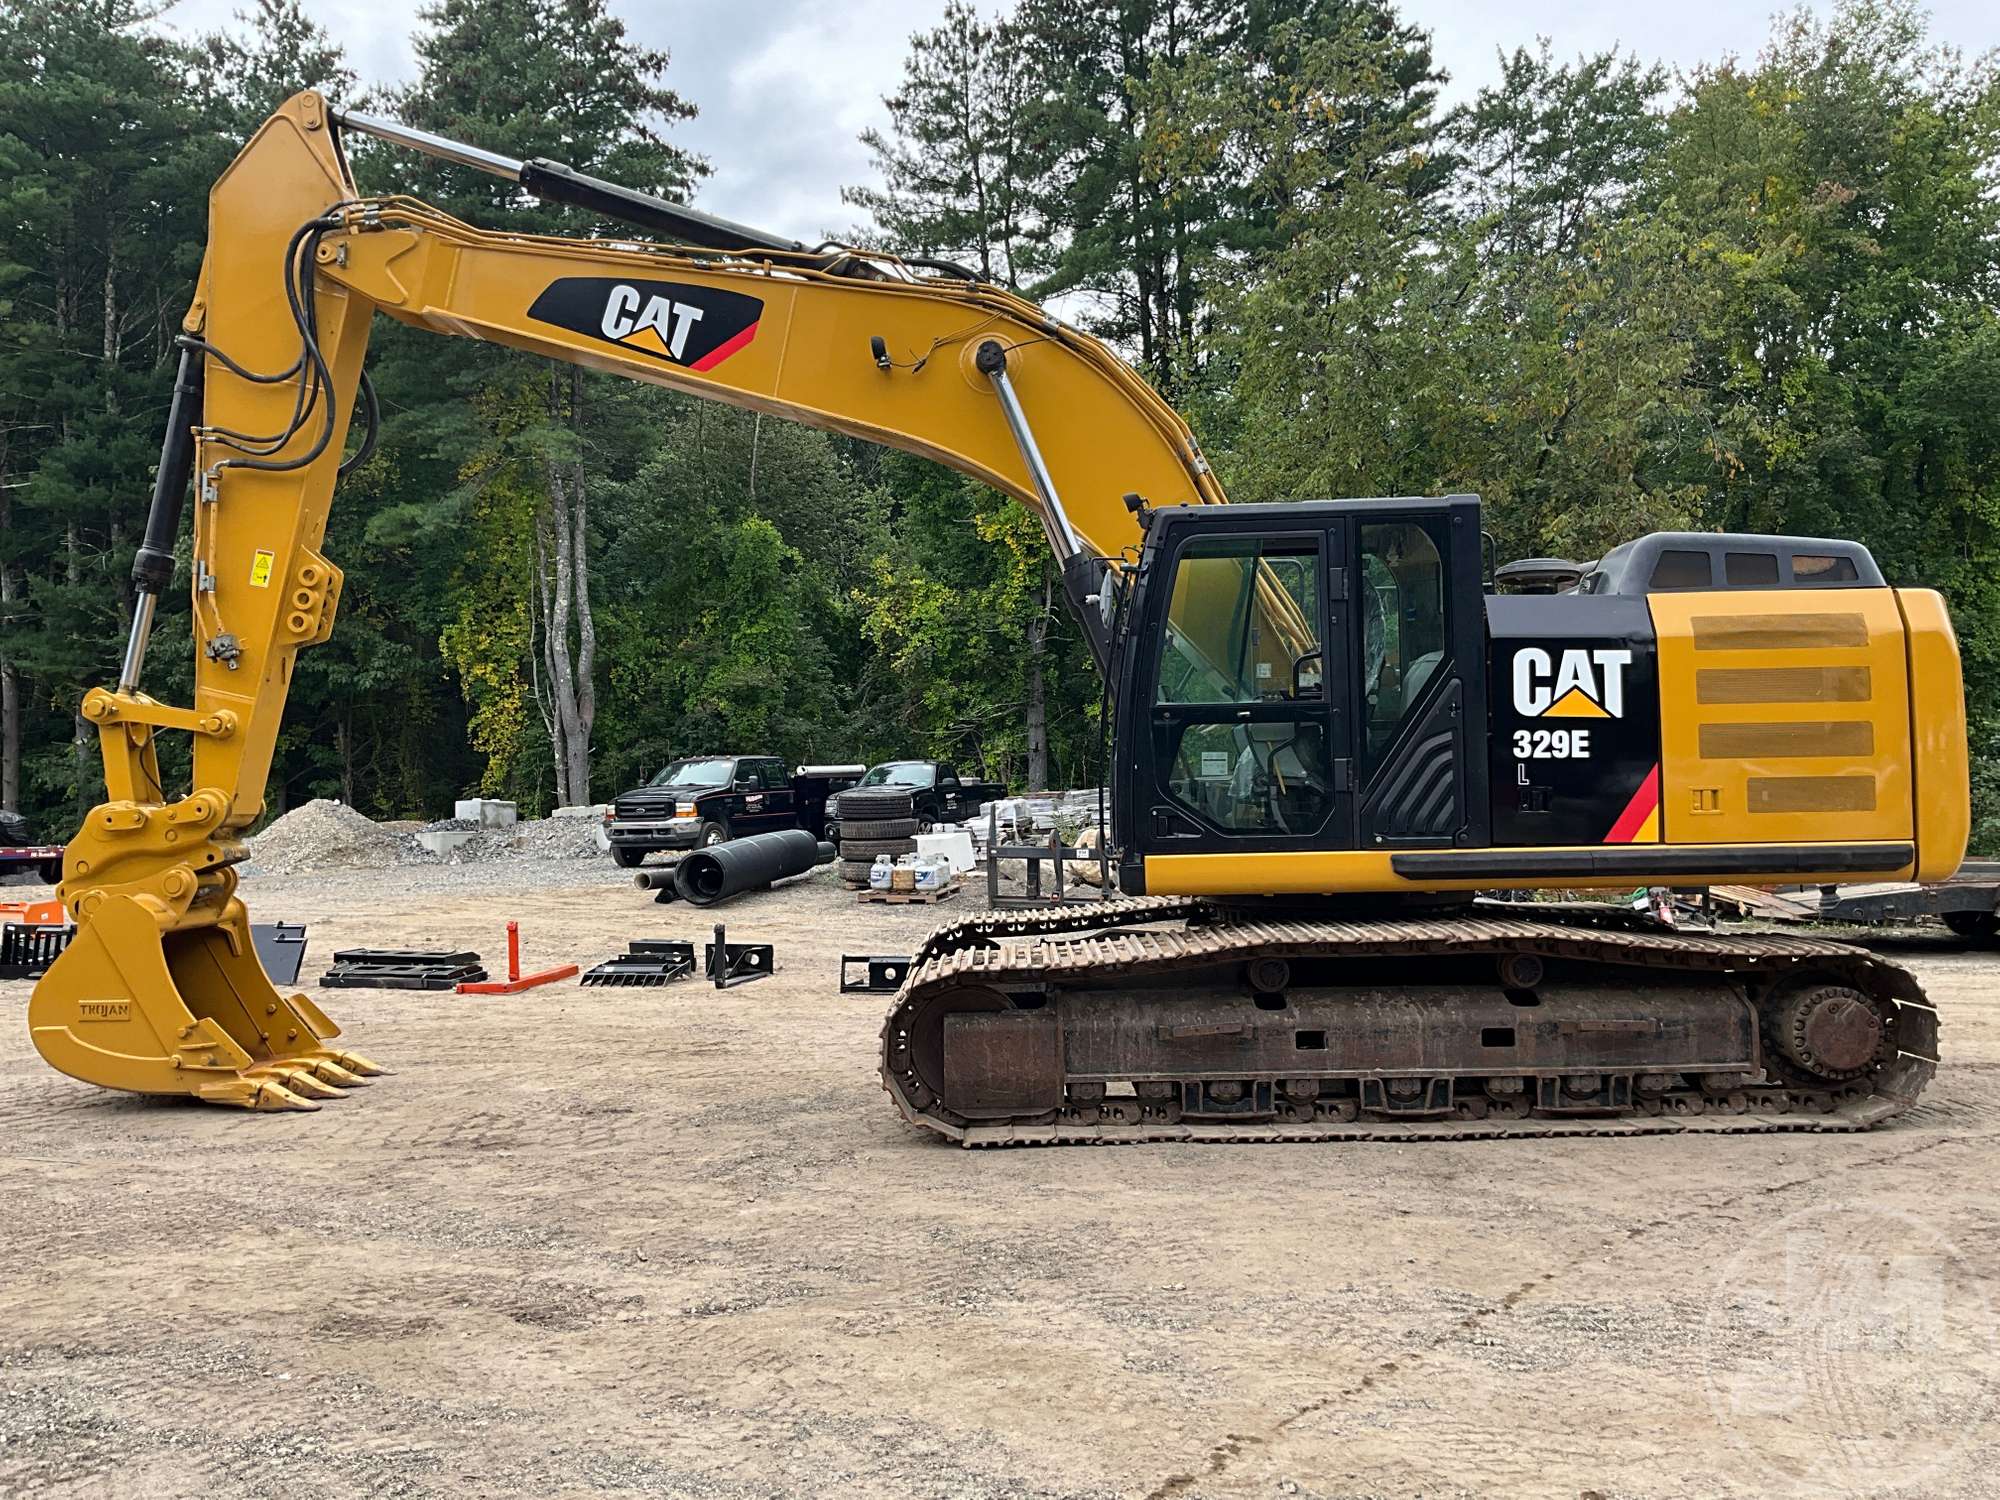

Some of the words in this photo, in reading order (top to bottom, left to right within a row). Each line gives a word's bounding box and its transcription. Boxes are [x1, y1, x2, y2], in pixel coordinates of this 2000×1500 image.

[601, 285, 704, 360] CAT
[1513, 647, 1632, 719] CAT
[1513, 730, 1590, 759] 329E
[1518, 763, 1530, 785] L
[80, 1004, 128, 1018] TROJAN
